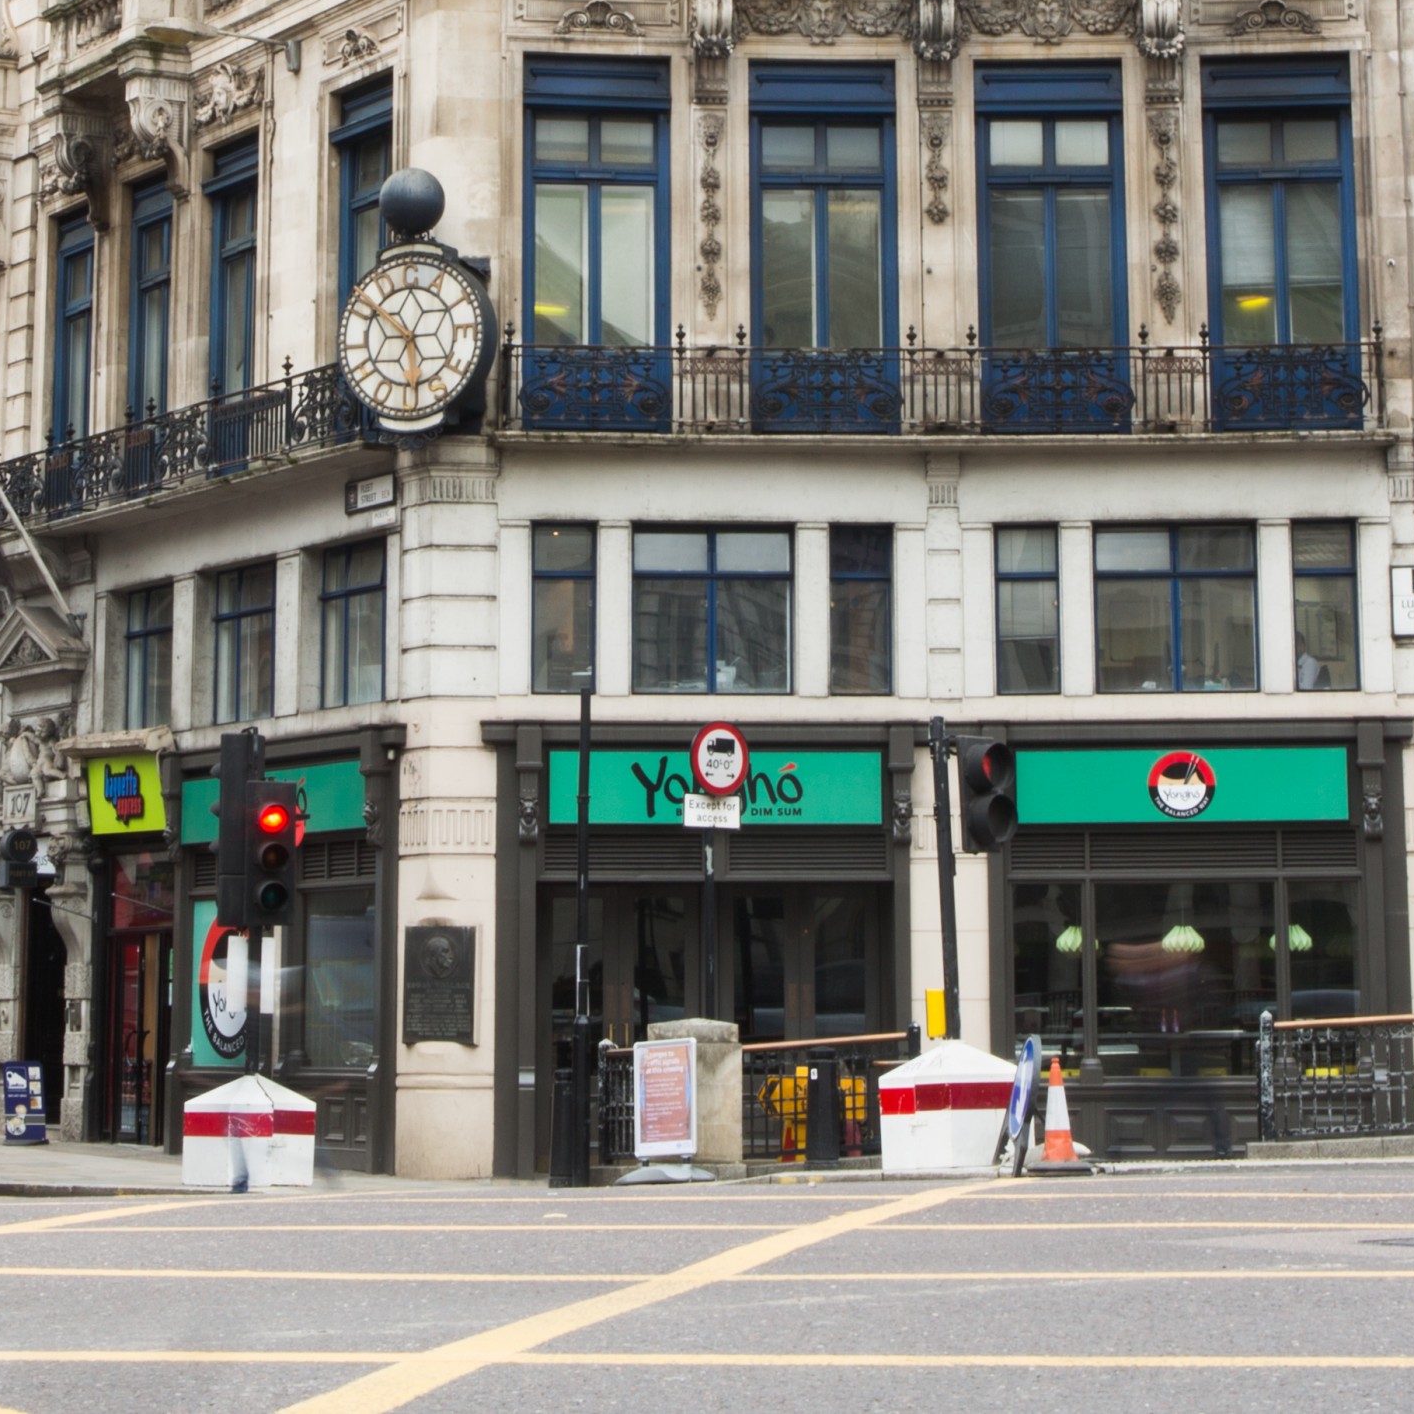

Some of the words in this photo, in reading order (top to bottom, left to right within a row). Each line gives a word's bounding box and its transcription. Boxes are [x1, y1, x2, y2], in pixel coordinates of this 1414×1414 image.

[361, 492, 376, 503] STREET
[10, 793, 31, 816] 107
[689, 799, 720, 811] Except
[722, 801, 736, 811] for
[751, 808, 773, 816] DIM
[777, 808, 802, 816] SUM
[1164, 806, 1199, 817] BALANCED
[696, 814, 728, 823] access
[14, 840, 31, 850] 107
[212, 1032, 245, 1054] BALANCED
